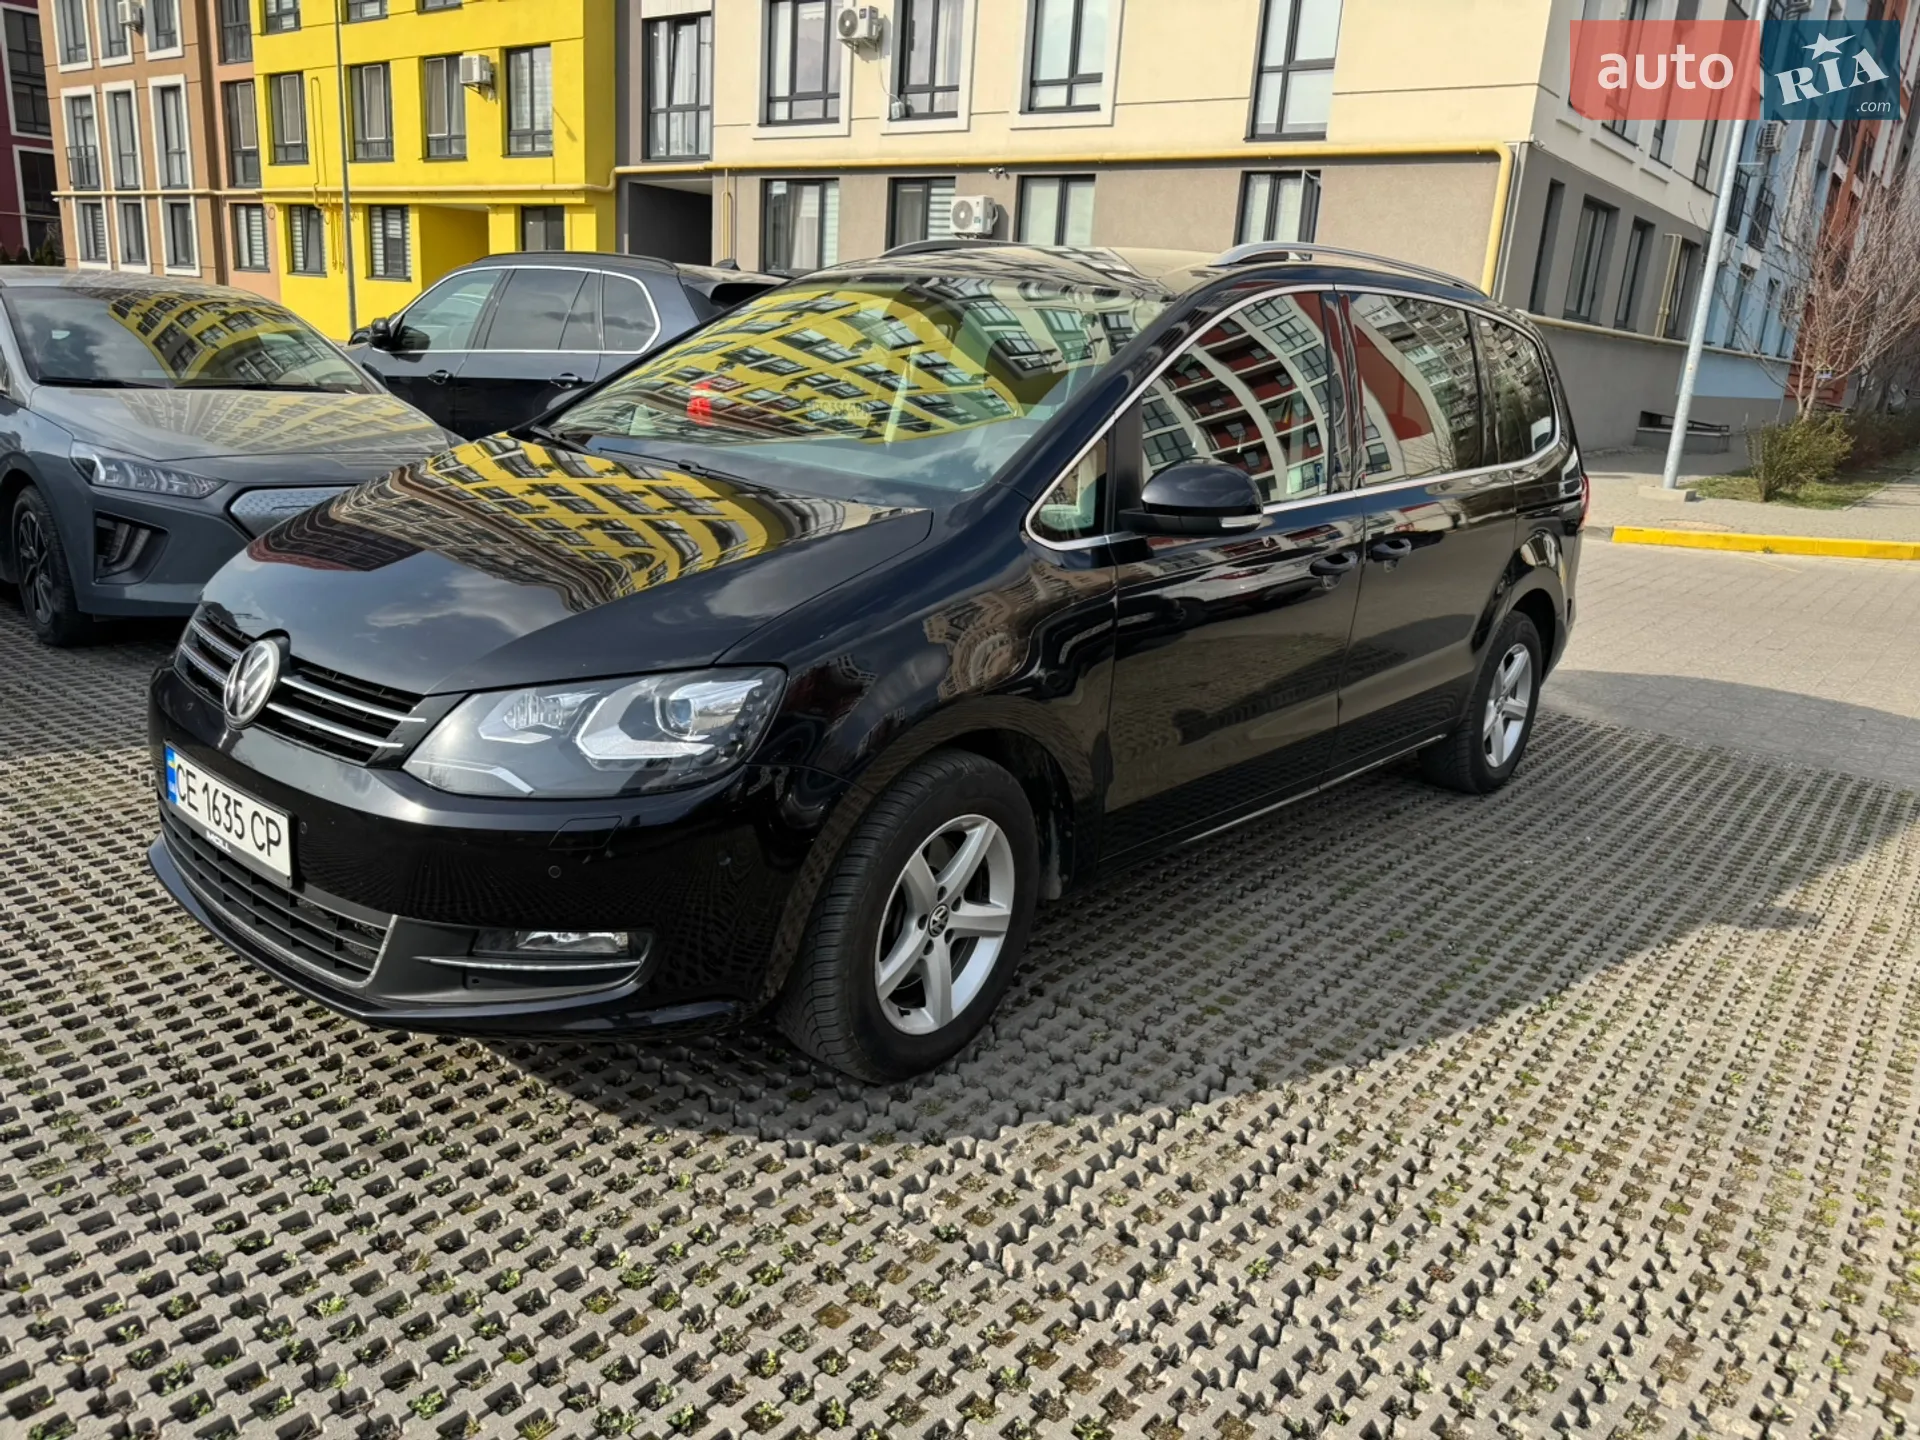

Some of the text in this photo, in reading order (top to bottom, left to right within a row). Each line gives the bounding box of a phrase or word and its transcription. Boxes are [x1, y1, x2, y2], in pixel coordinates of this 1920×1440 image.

[176, 764, 281, 857] CE 1635 CP
